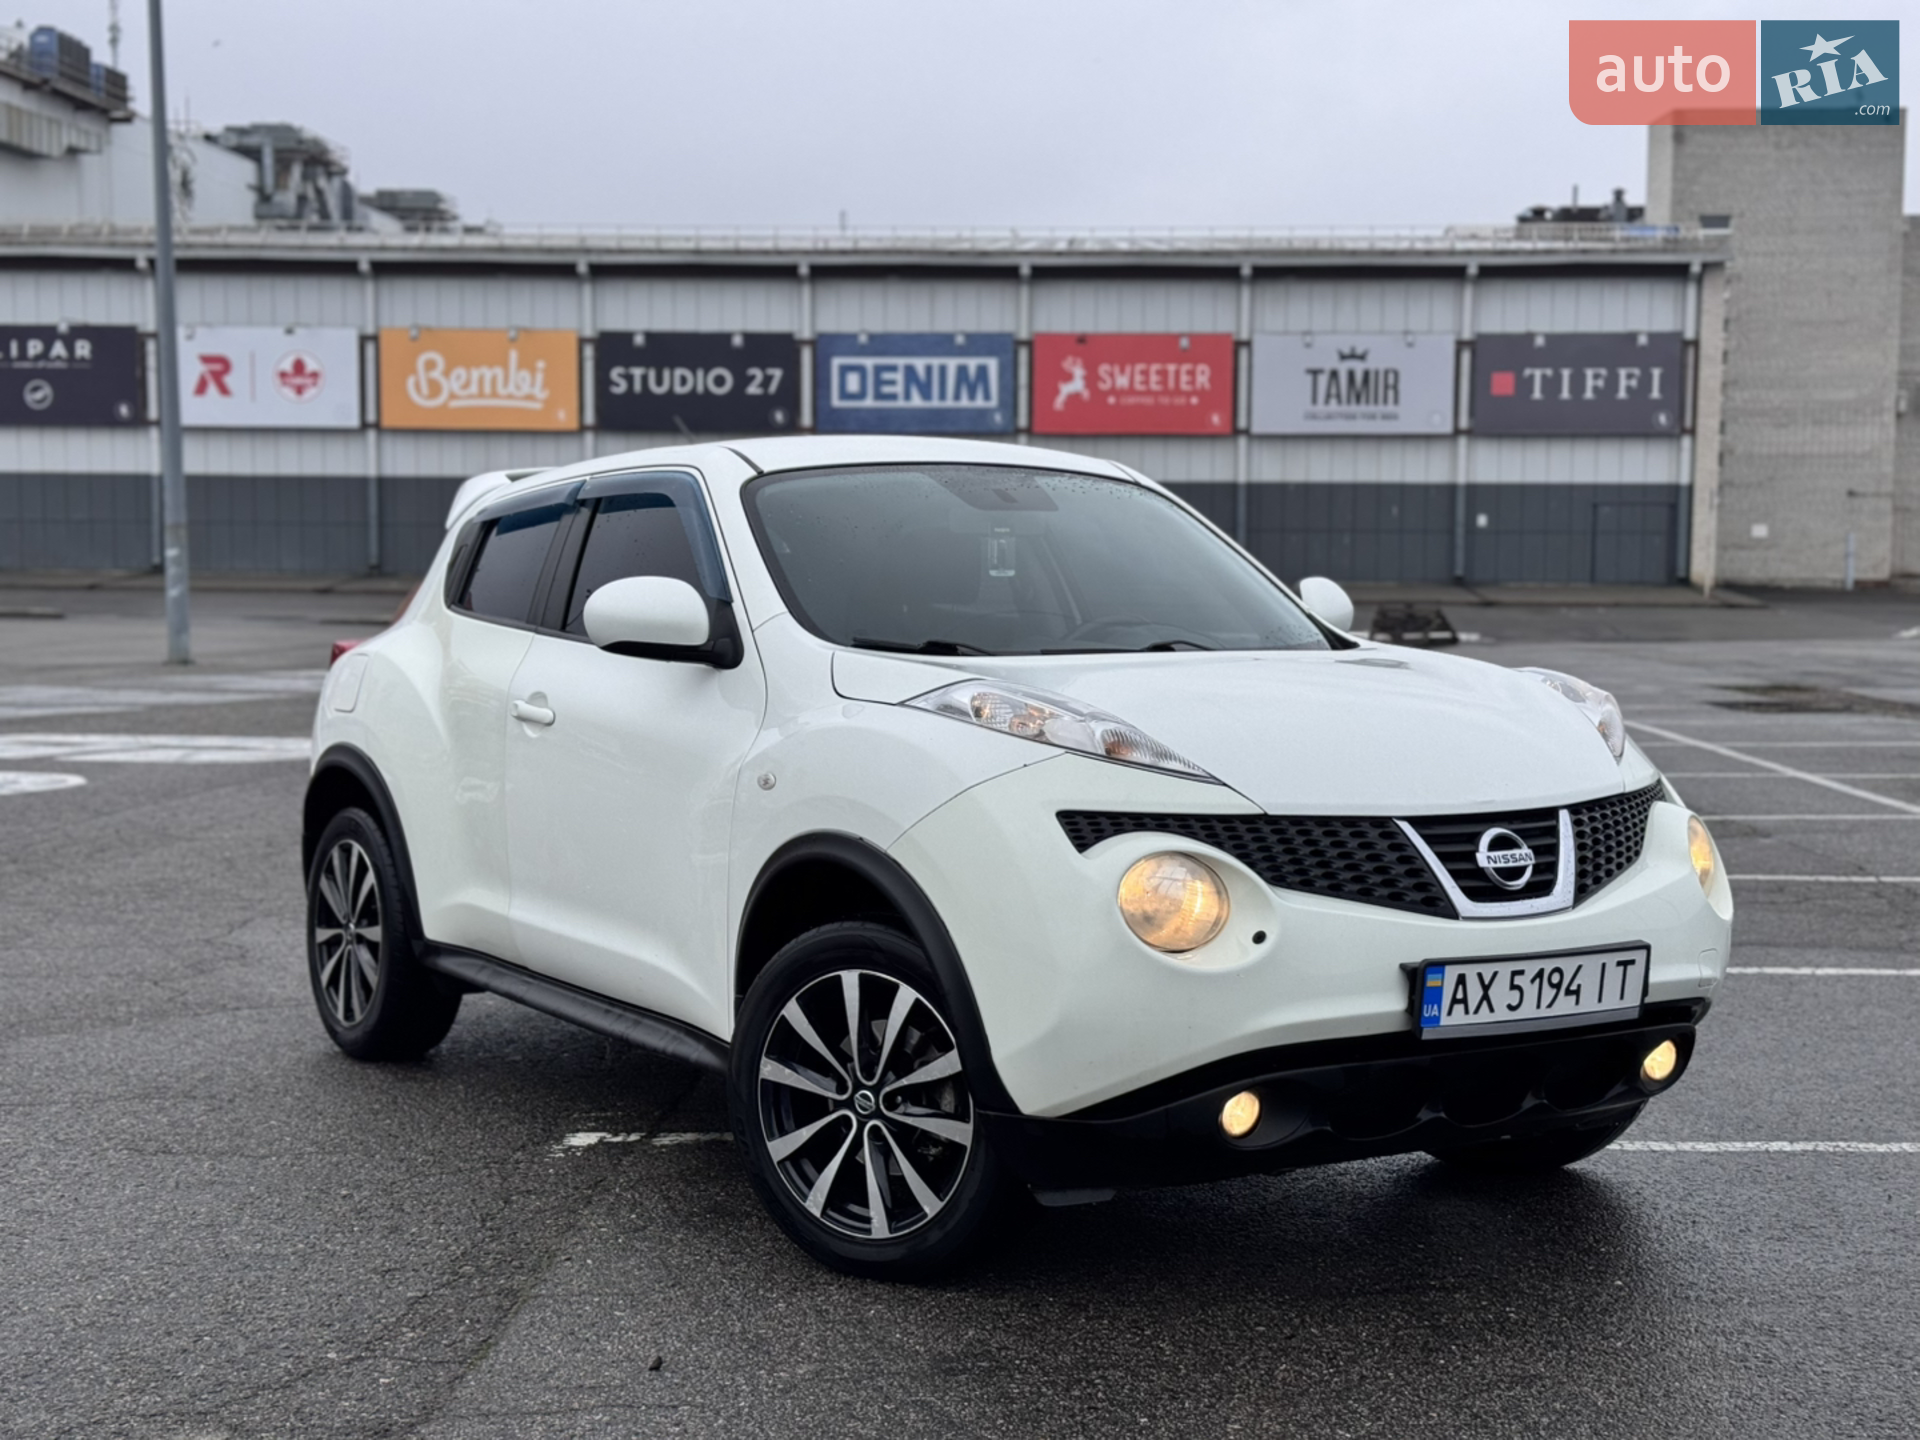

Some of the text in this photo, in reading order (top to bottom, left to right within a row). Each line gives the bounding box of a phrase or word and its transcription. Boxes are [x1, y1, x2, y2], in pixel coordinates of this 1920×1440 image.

[0, 338, 92, 360] IPAR
[406, 348, 550, 408] Bembi
[609, 366, 784, 395] STUDIO 27
[837, 362, 993, 402] DENIM
[1097, 363, 1212, 392] SWEETER
[1305, 368, 1400, 406] TAMIR
[1522, 366, 1663, 400] TIFFI
[1486, 852, 1533, 866] NISSAN
[1446, 958, 1636, 1017] AX 5194 IT
[1423, 1004, 1439, 1018] UA
